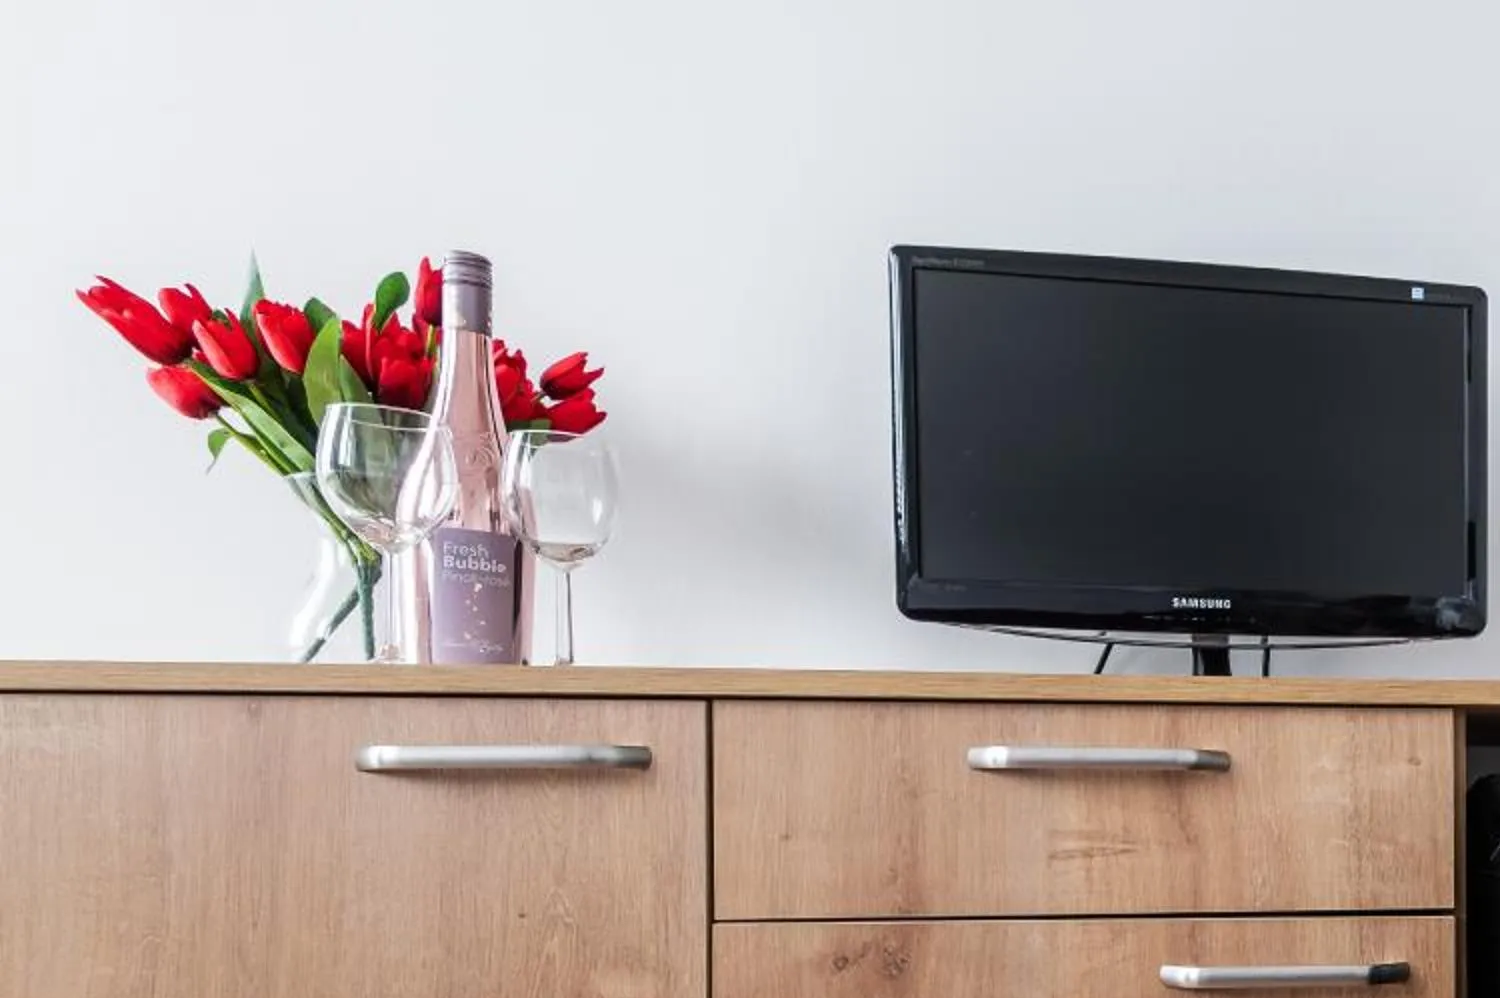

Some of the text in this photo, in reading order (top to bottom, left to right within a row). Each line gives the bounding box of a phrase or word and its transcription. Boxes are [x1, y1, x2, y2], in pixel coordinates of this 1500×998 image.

[443, 541, 490, 558] Fresh
[443, 555, 507, 573] Bubble
[1172, 597, 1231, 609] SAMSUNG
